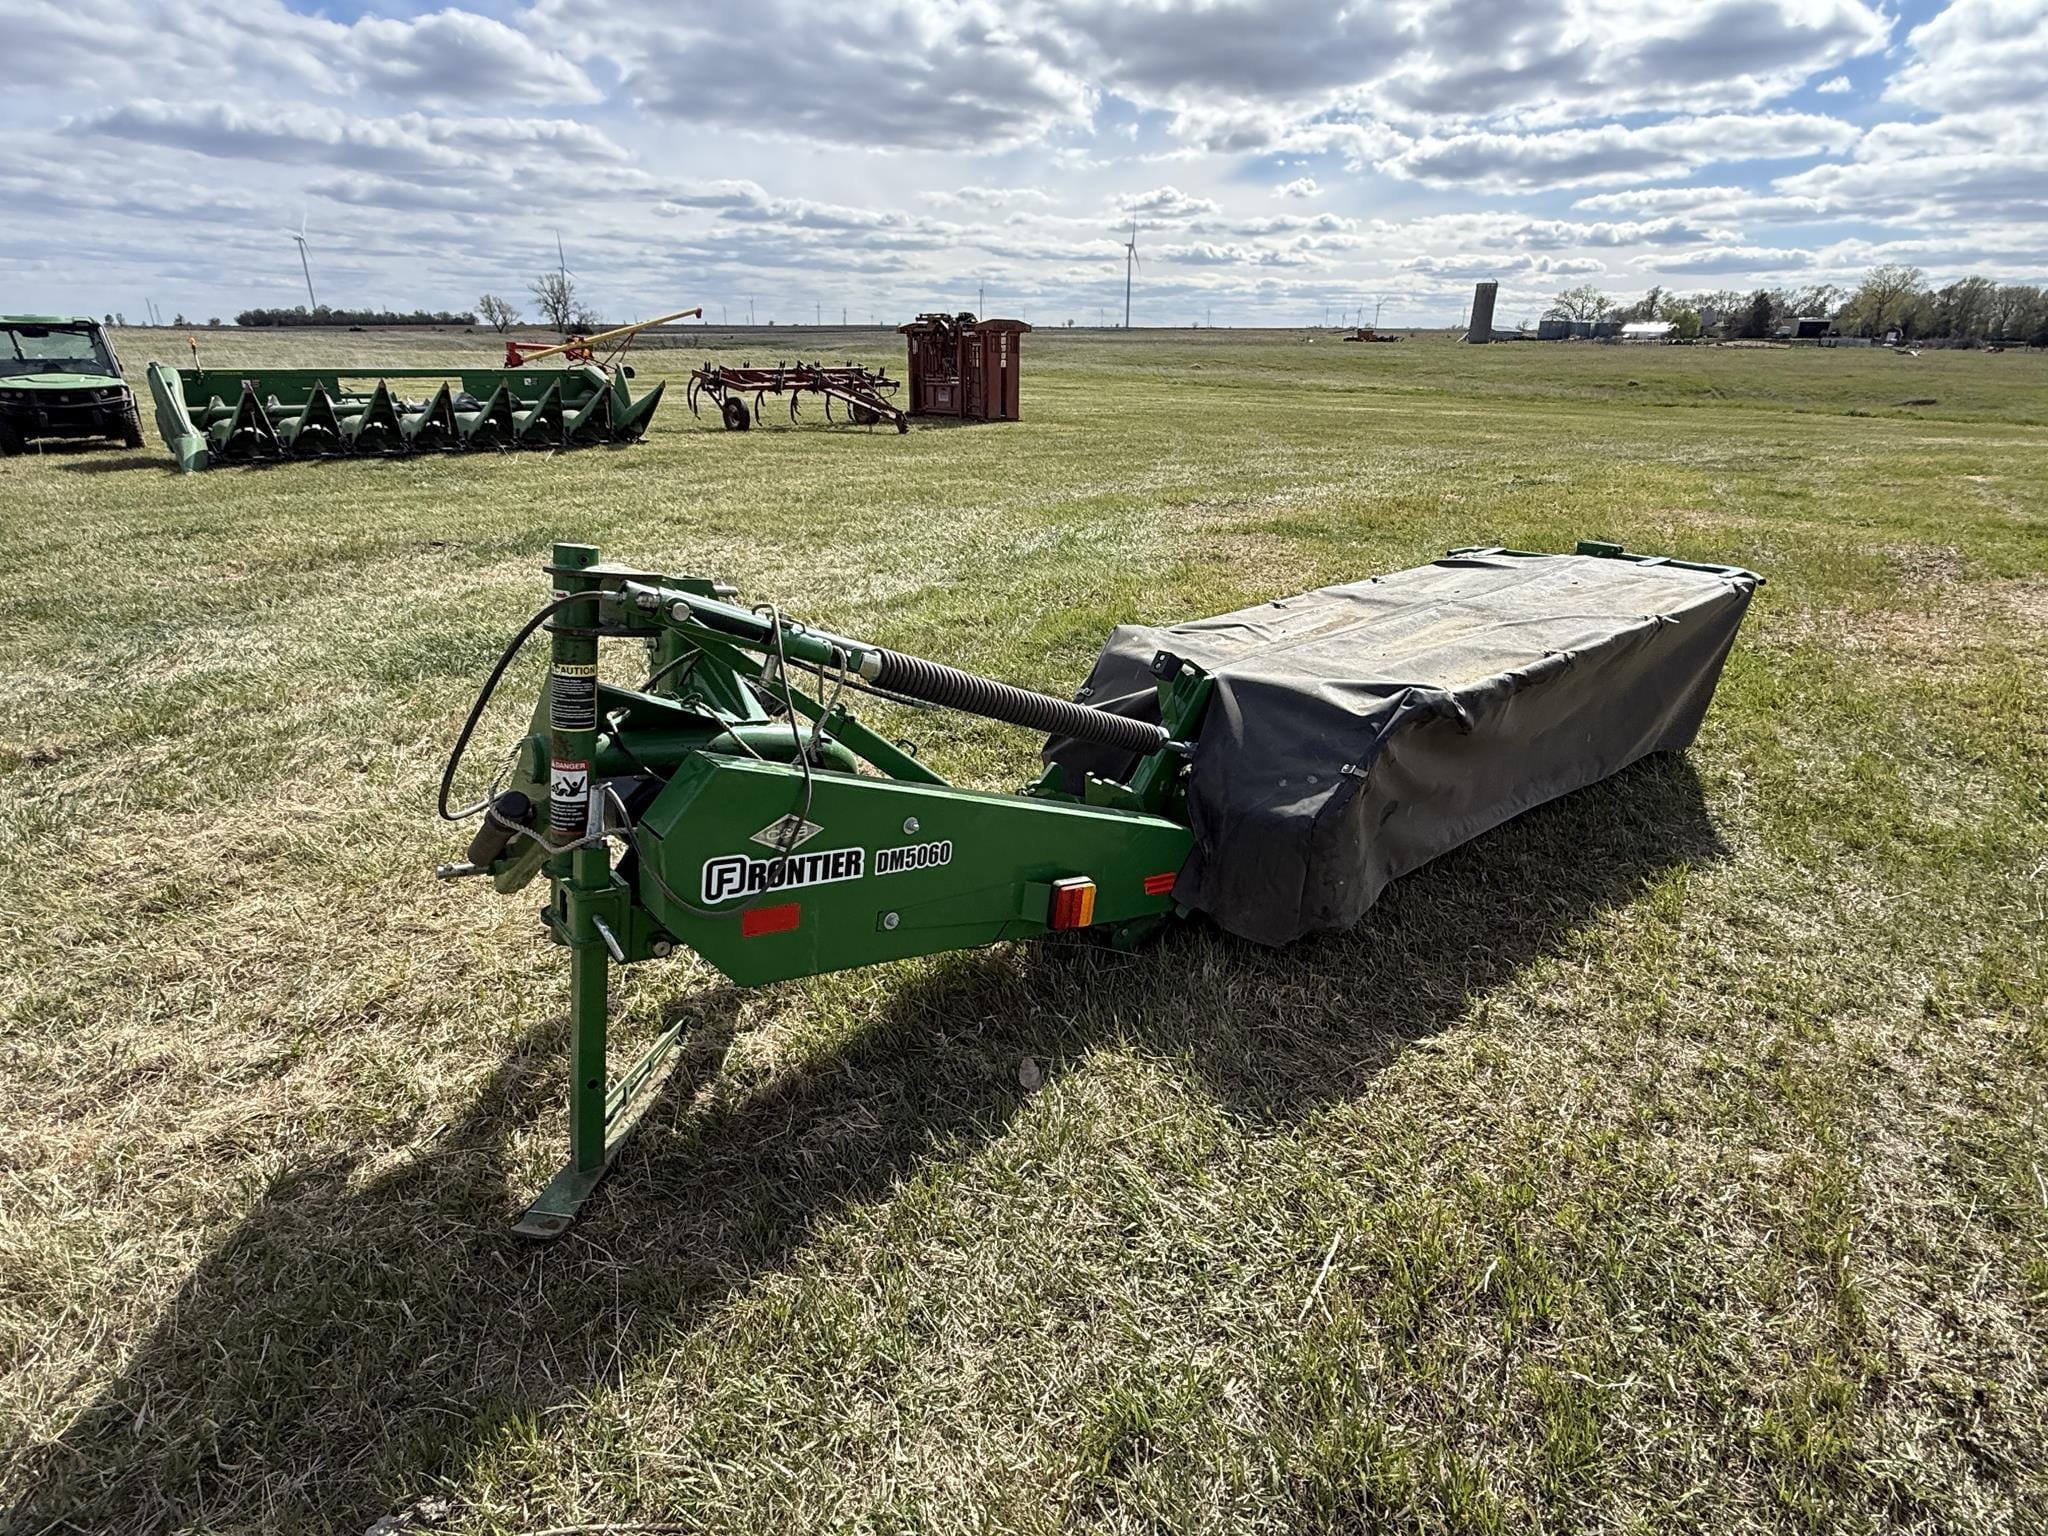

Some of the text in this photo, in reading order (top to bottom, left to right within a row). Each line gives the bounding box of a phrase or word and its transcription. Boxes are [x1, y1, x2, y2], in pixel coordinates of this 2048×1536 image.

[555, 666, 595, 675] CAUTION
[555, 761, 586, 769] DANGER
[705, 843, 951, 901] FRONTIER DM5060
